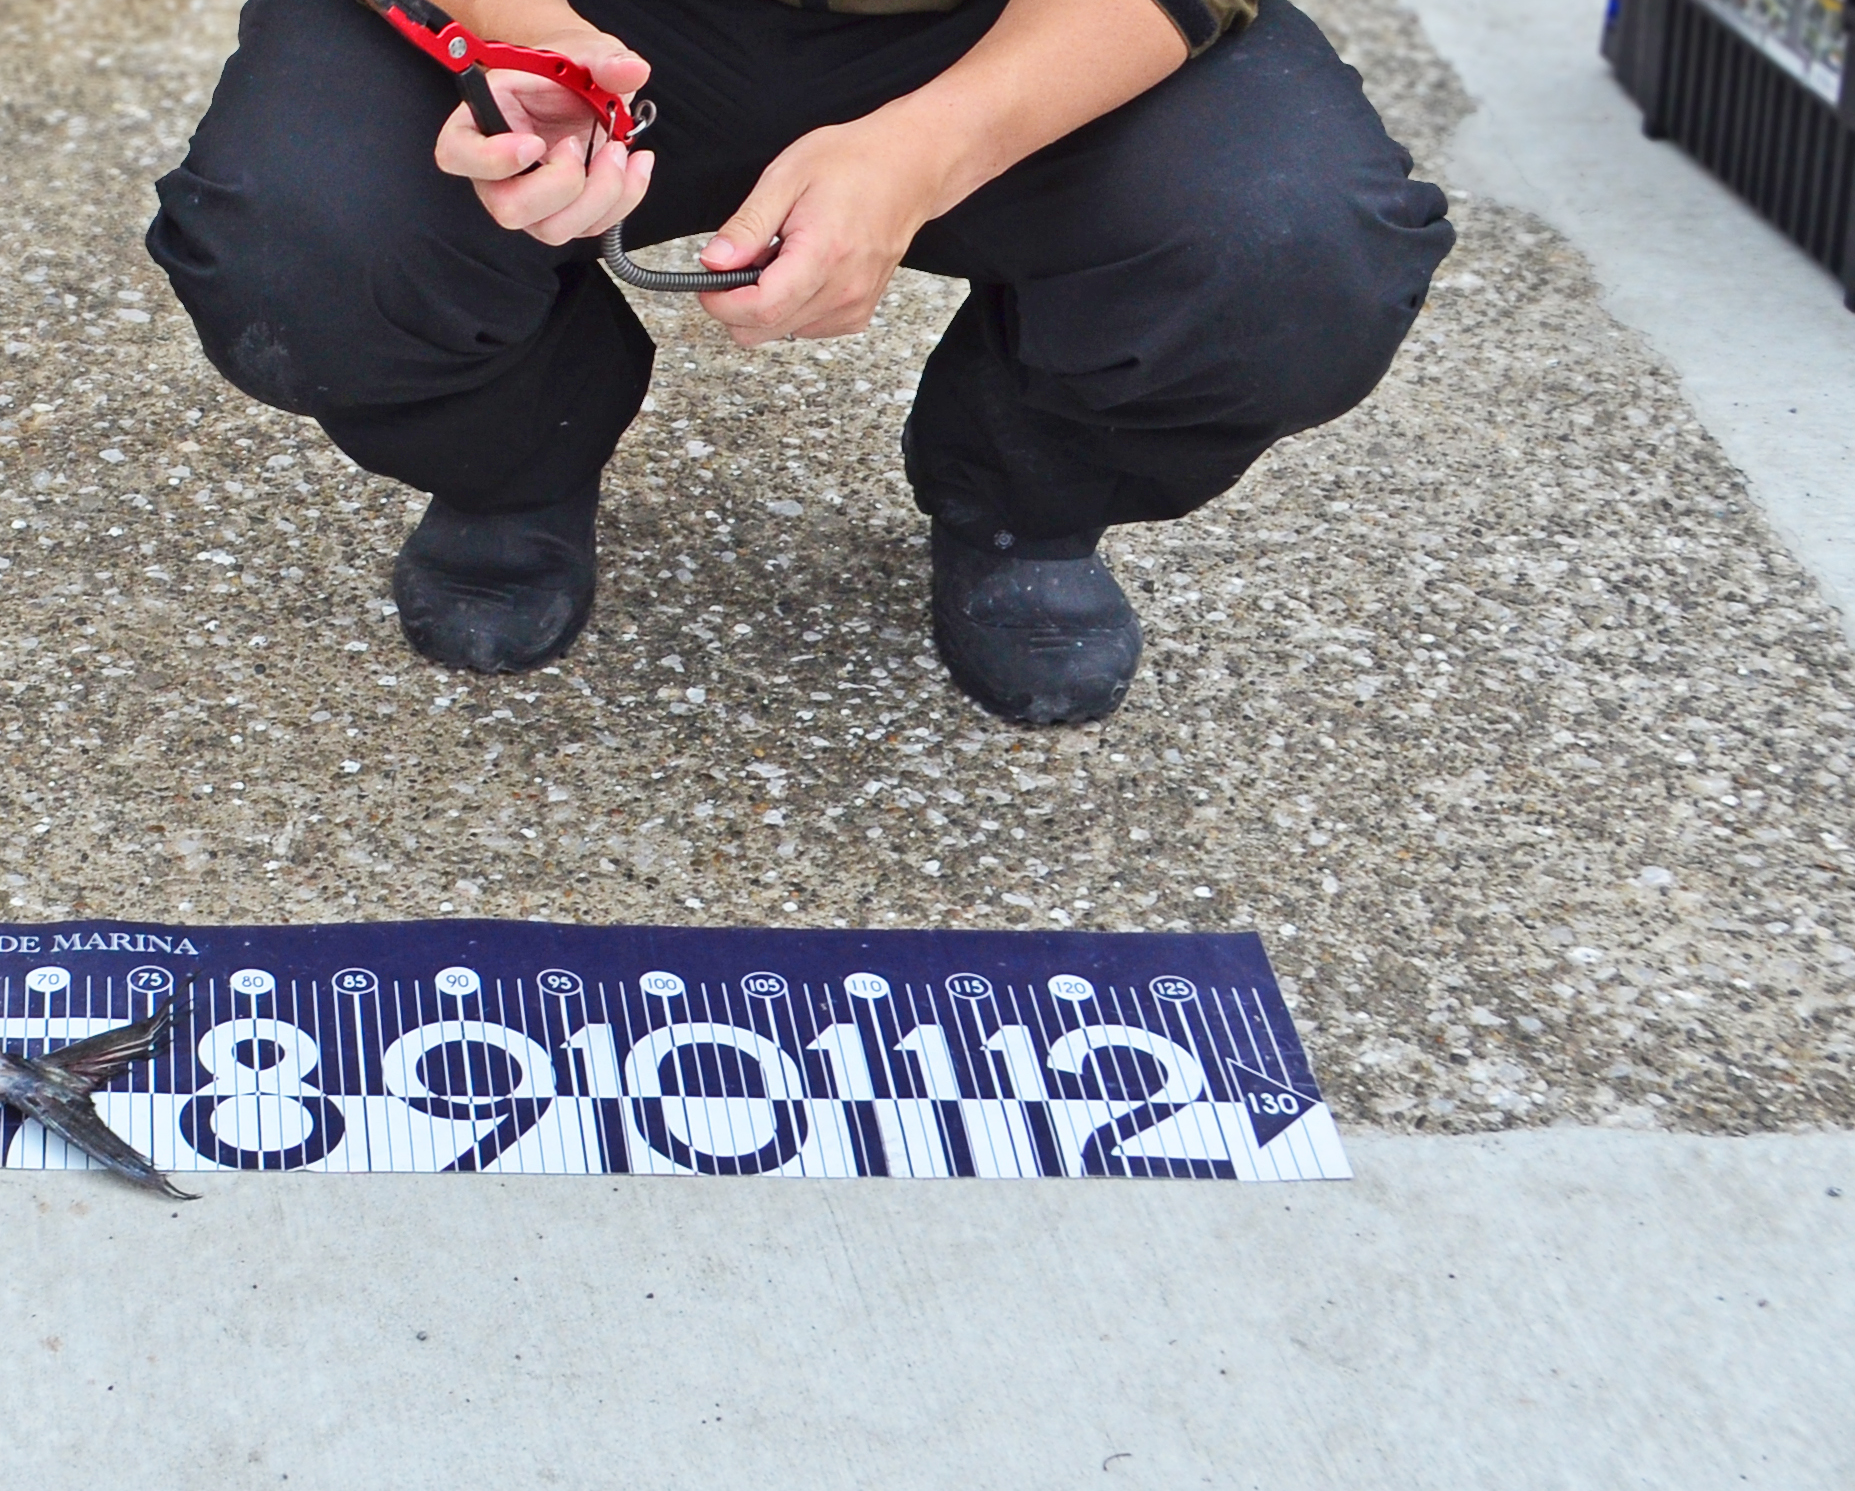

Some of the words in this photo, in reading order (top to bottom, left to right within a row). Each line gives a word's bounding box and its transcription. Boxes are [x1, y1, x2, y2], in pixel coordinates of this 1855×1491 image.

[50, 932, 200, 956] MARINA
[36, 973, 60, 986] 70
[138, 972, 163, 987] 75
[241, 975, 265, 989] 80
[343, 975, 367, 989] 85
[446, 974, 469, 989] 90
[547, 976, 572, 990] 95
[646, 977, 677, 992] 100
[748, 978, 780, 993] 105
[850, 979, 883, 993] 110
[952, 979, 986, 994] 115
[1054, 981, 1087, 995] 120
[1155, 982, 1190, 996] 125
[179, 1018, 345, 1171] 8
[382, 1020, 557, 1173] 9
[559, 1021, 808, 1176] 10
[805, 1023, 978, 1178] 11
[979, 1024, 1238, 1180] 12
[1247, 1091, 1300, 1117] 130
